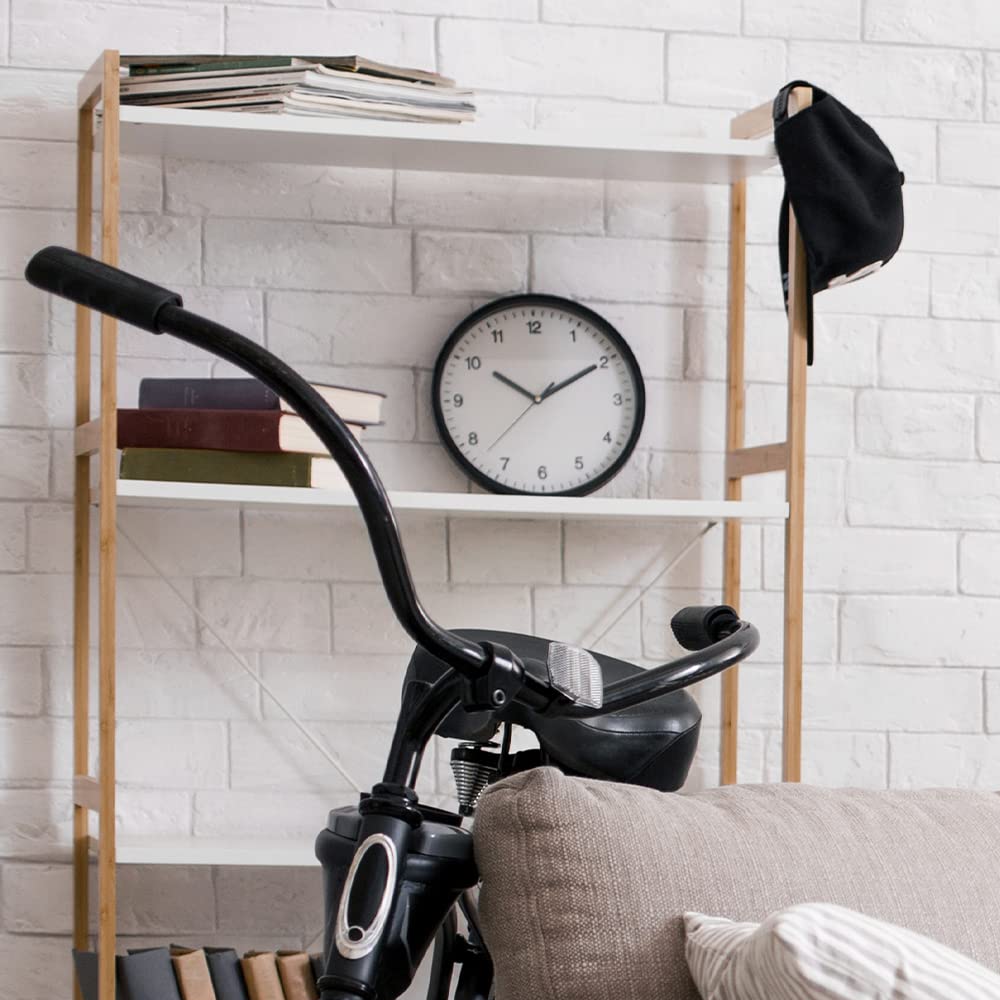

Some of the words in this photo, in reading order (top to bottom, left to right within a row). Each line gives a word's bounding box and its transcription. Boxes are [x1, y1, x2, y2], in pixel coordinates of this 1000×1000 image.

[526, 320, 542, 334] 12
[491, 329, 504, 343] 11
[569, 330, 576, 342] 1
[465, 356, 481, 370] 10
[599, 356, 609, 369] 2
[453, 394, 464, 407] 9
[613, 393, 623, 406] 3
[468, 432, 478, 445] 8
[602, 432, 612, 443] 4
[499, 457, 510, 471] 7
[574, 456, 584, 469] 5
[538, 466, 548, 479] 6
